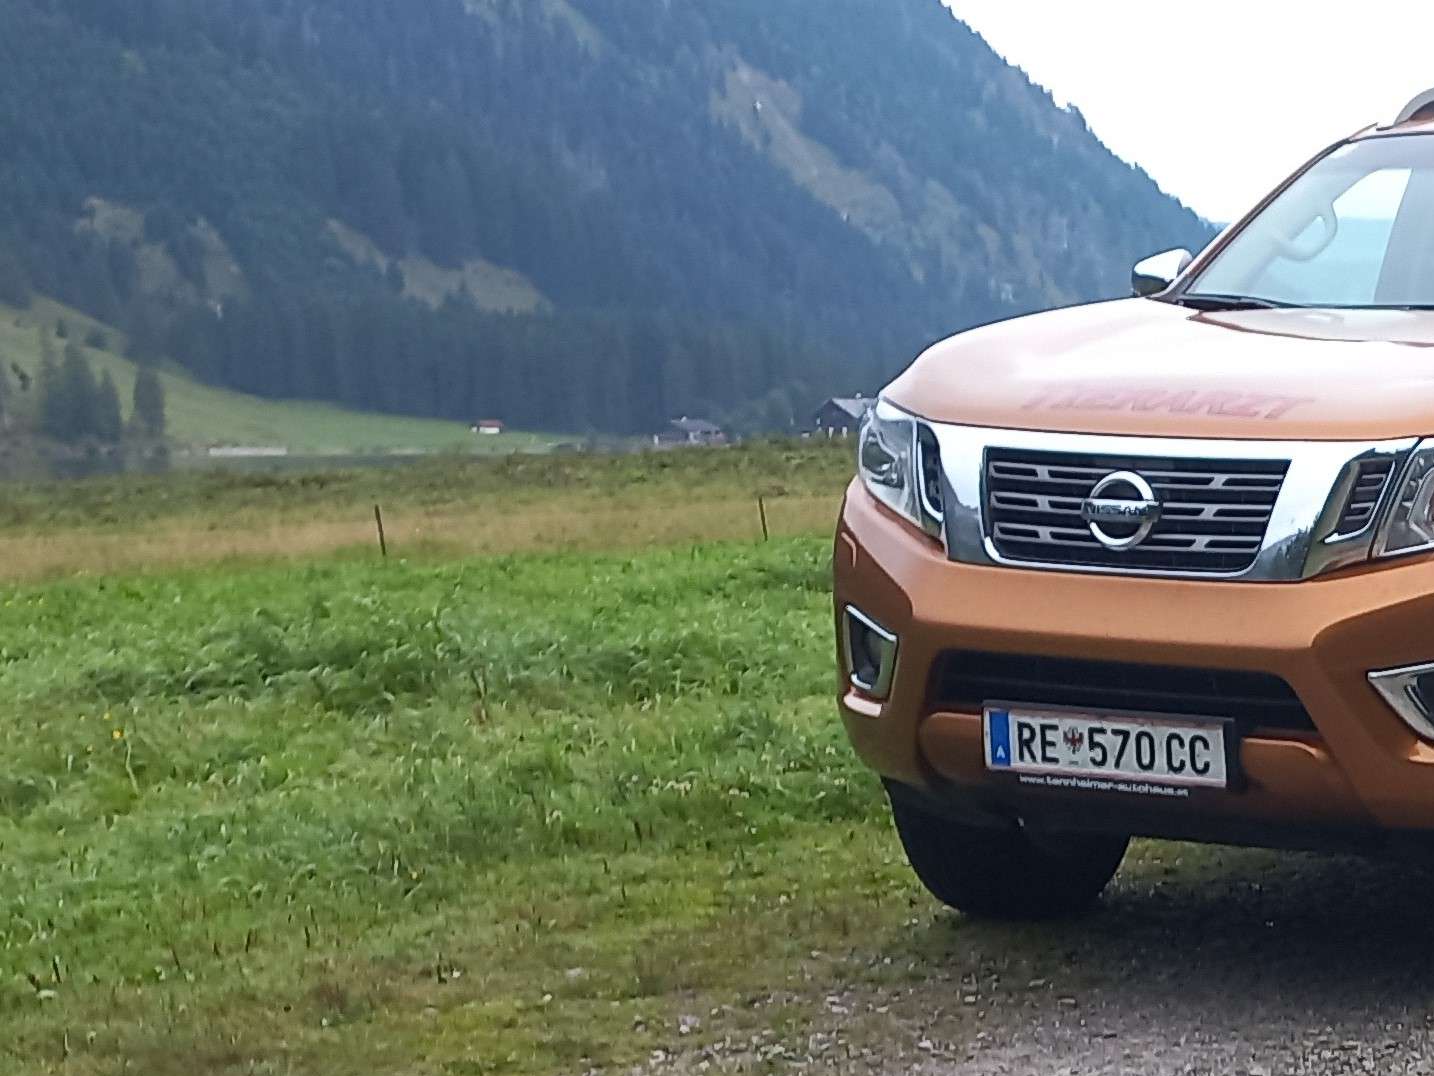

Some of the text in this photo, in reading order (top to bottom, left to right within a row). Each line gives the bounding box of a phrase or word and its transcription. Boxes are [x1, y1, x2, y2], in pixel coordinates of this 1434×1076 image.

[1016, 720, 1210, 775] RE 570 CC
